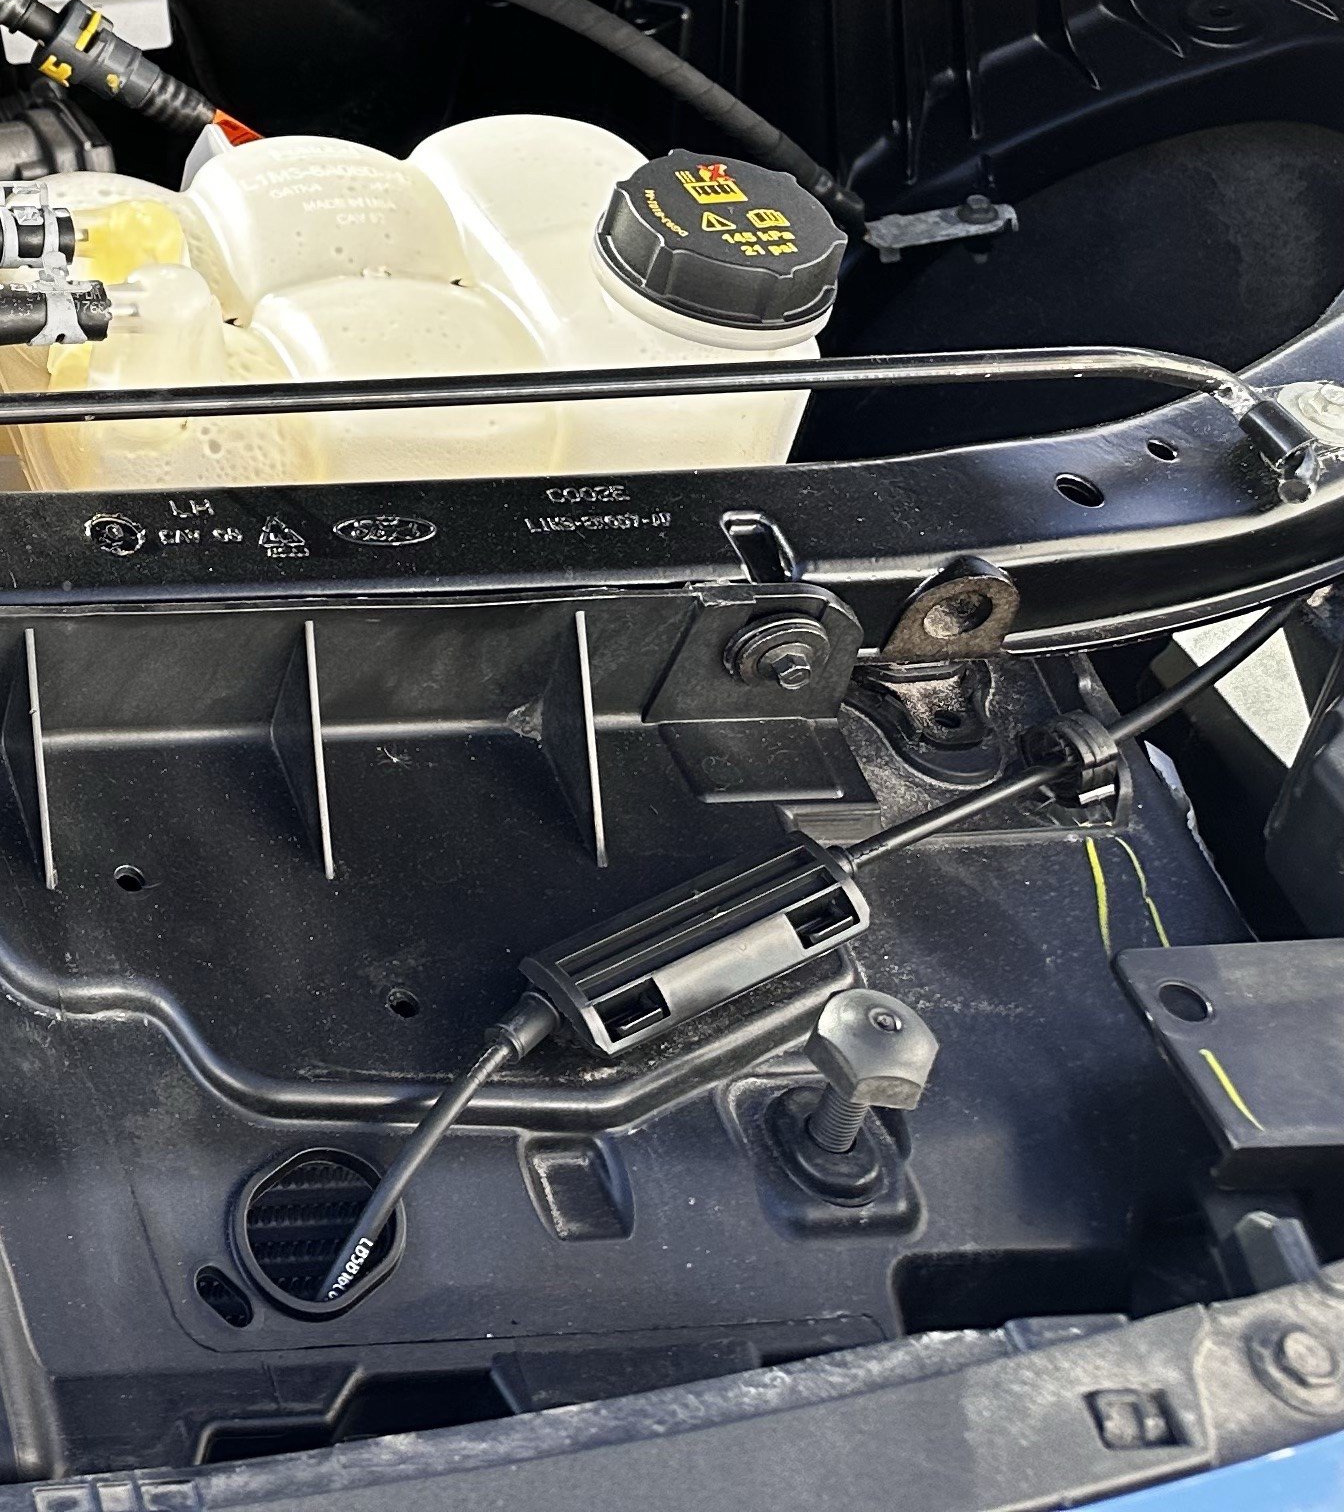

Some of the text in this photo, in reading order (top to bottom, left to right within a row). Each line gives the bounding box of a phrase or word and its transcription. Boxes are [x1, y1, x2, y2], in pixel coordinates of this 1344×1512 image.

[721, 230, 795, 244] 145 kPa
[740, 242, 799, 256] 21 psi
[169, 499, 214, 518] LH
